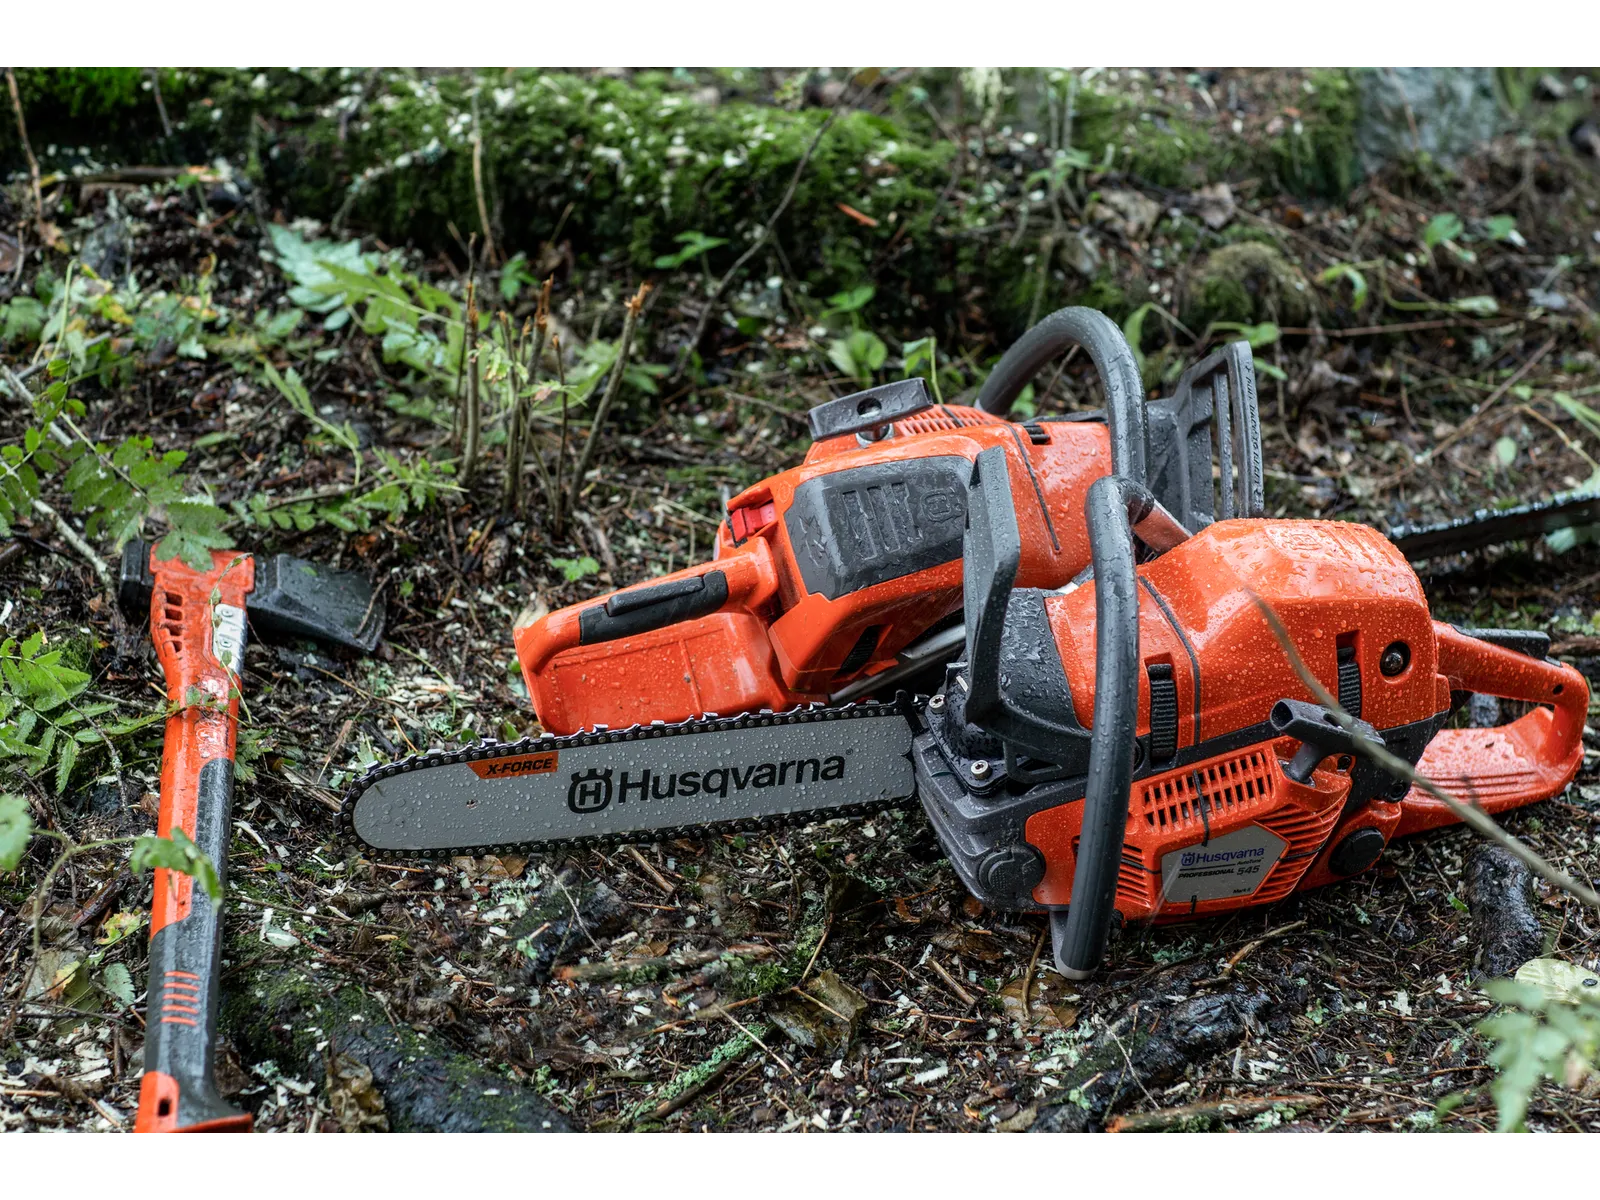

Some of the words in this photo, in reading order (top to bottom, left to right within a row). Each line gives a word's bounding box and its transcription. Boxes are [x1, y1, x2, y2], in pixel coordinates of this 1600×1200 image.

[485, 757, 553, 777] X-FORCE
[617, 755, 846, 804] Husqvarna
[1196, 847, 1264, 863] Husqvarna
[1178, 868, 1235, 879] PROFESSIONAL
[1236, 865, 1261, 876] 545
